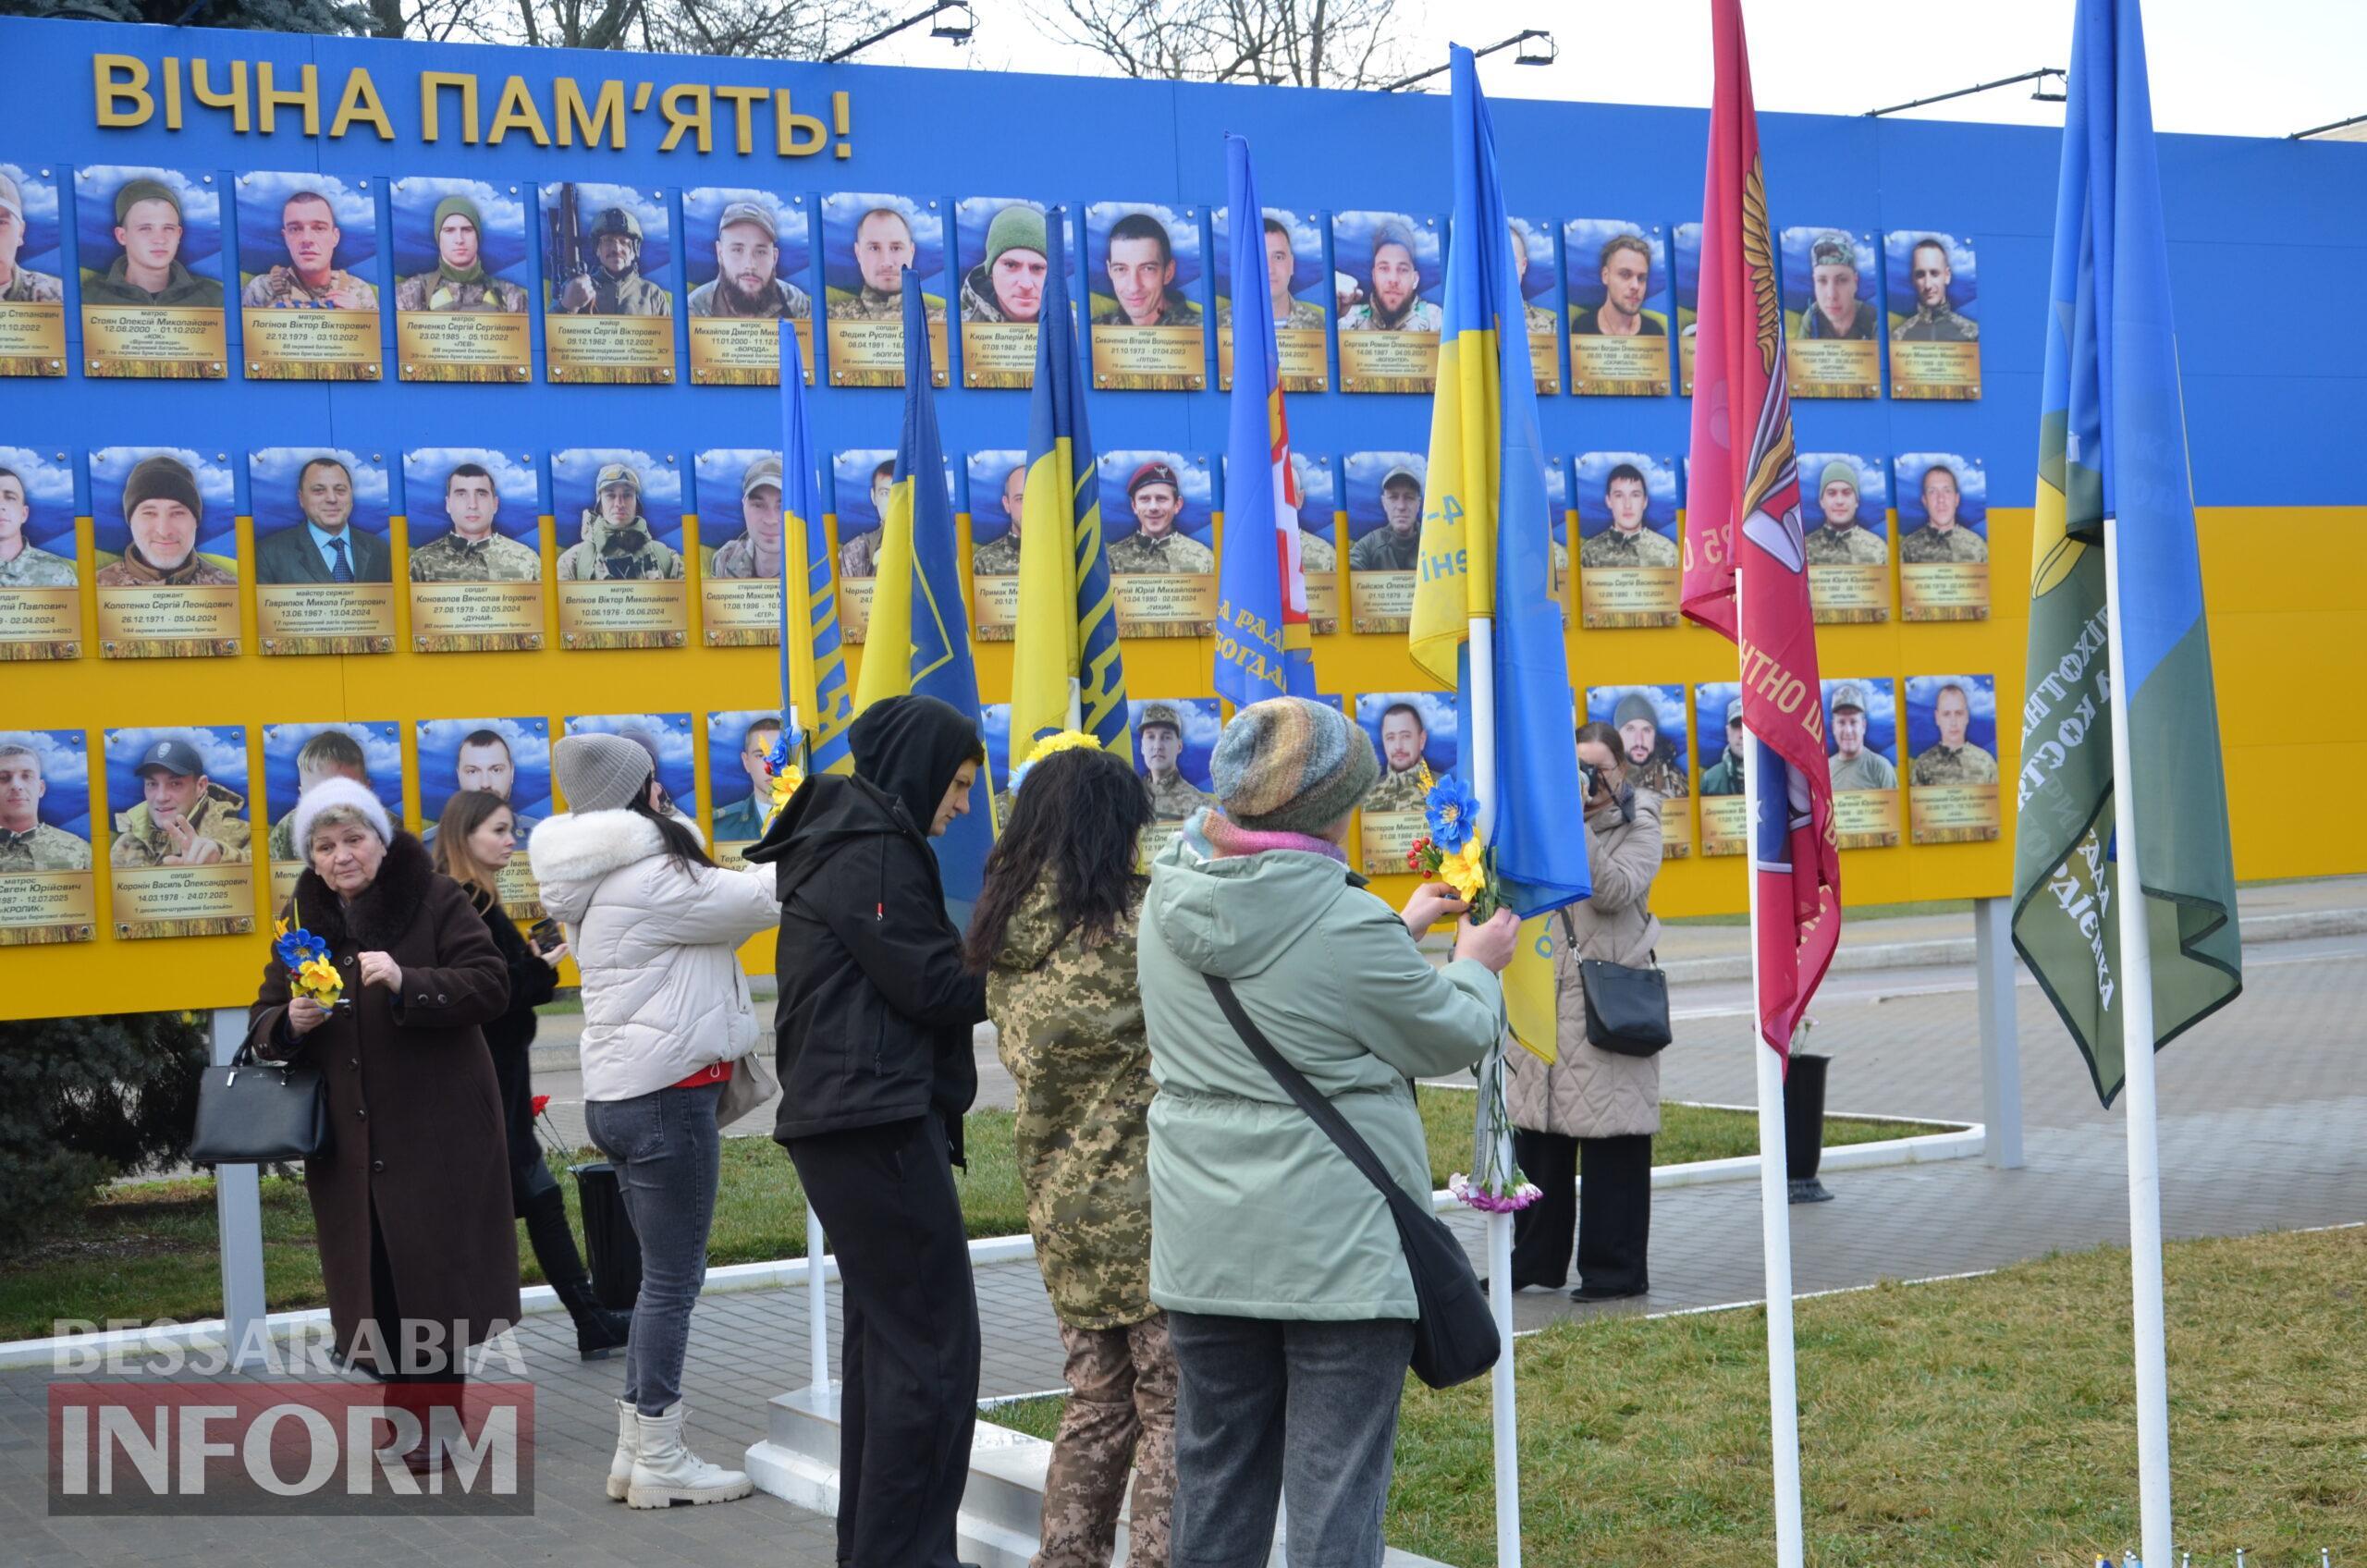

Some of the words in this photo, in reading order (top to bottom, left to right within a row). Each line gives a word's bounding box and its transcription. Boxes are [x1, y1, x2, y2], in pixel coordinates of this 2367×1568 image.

[92, 53, 396, 140] ВІЧНА
[8, 309, 59, 318] Степанович
[90, 316, 117, 325] Стоян
[119, 316, 154, 326] Олексій
[157, 318, 218, 327] Миколайович
[251, 320, 288, 329] Логінов
[289, 321, 319, 330] Віктор
[321, 321, 372, 331] Вікторович
[160, 326, 207, 335] 01.10.2022
[407, 322, 446, 331] Левченко
[448, 322, 474, 332] Сергій
[475, 323, 521, 333] Сергійович
[558, 326, 592, 335] Гоменюк
[594, 326, 618, 337] Сергій
[619, 327, 661, 337] Вікторович
[694, 327, 730, 337] Михайлов
[731, 327, 759, 337] Дмитро
[266, 333, 308, 341] 22.12.1979
[317, 333, 360, 341] 03.10.2022
[840, 331, 866, 340] Федик
[868, 331, 897, 340] Руслан
[969, 333, 993, 341] Кидик
[995, 333, 1024, 341] Валерій
[1129, 337, 1151, 346] Віталій
[1151, 337, 1201, 346] Володимирович
[1369, 340, 1391, 349] Роман
[845, 587, 874, 595] Черноб
[979, 589, 1006, 597] Примак
[1134, 586, 1156, 594] Юрій
[416, 595, 460, 604] Коновалов
[462, 594, 500, 604] Вячеслав
[502, 594, 537, 603] Ігорович
[565, 595, 596, 605] Веліков
[597, 595, 623, 605] Віктор
[625, 595, 681, 604] Миколайович
[706, 592, 745, 601] Сидоренко
[746, 592, 775, 601] Максим
[18, 602, 67, 611] Павлович
[104, 601, 150, 610] Колотенко
[152, 601, 180, 610] Сергій
[182, 600, 233, 609] Леонідович
[264, 599, 304, 608] Гаврилюк
[306, 598, 338, 606] Микола
[340, 598, 386, 607] Григорович
[10, 616, 55, 624] 02.04.2024
[174, 615, 217, 623] 05.04.2024
[1215, 630, 1288, 696] БОГДА
[1741, 638, 1807, 714] НТНО
[29, 884, 81, 894] Юрійович
[117, 881, 151, 891] Коронін
[152, 880, 182, 889] Василь
[183, 878, 249, 889] Олександрович
[28, 894, 69, 902] 12.07.2025
[187, 891, 229, 900] 24.07.2025
[2048, 864, 2115, 1012] ДІЄНКА
